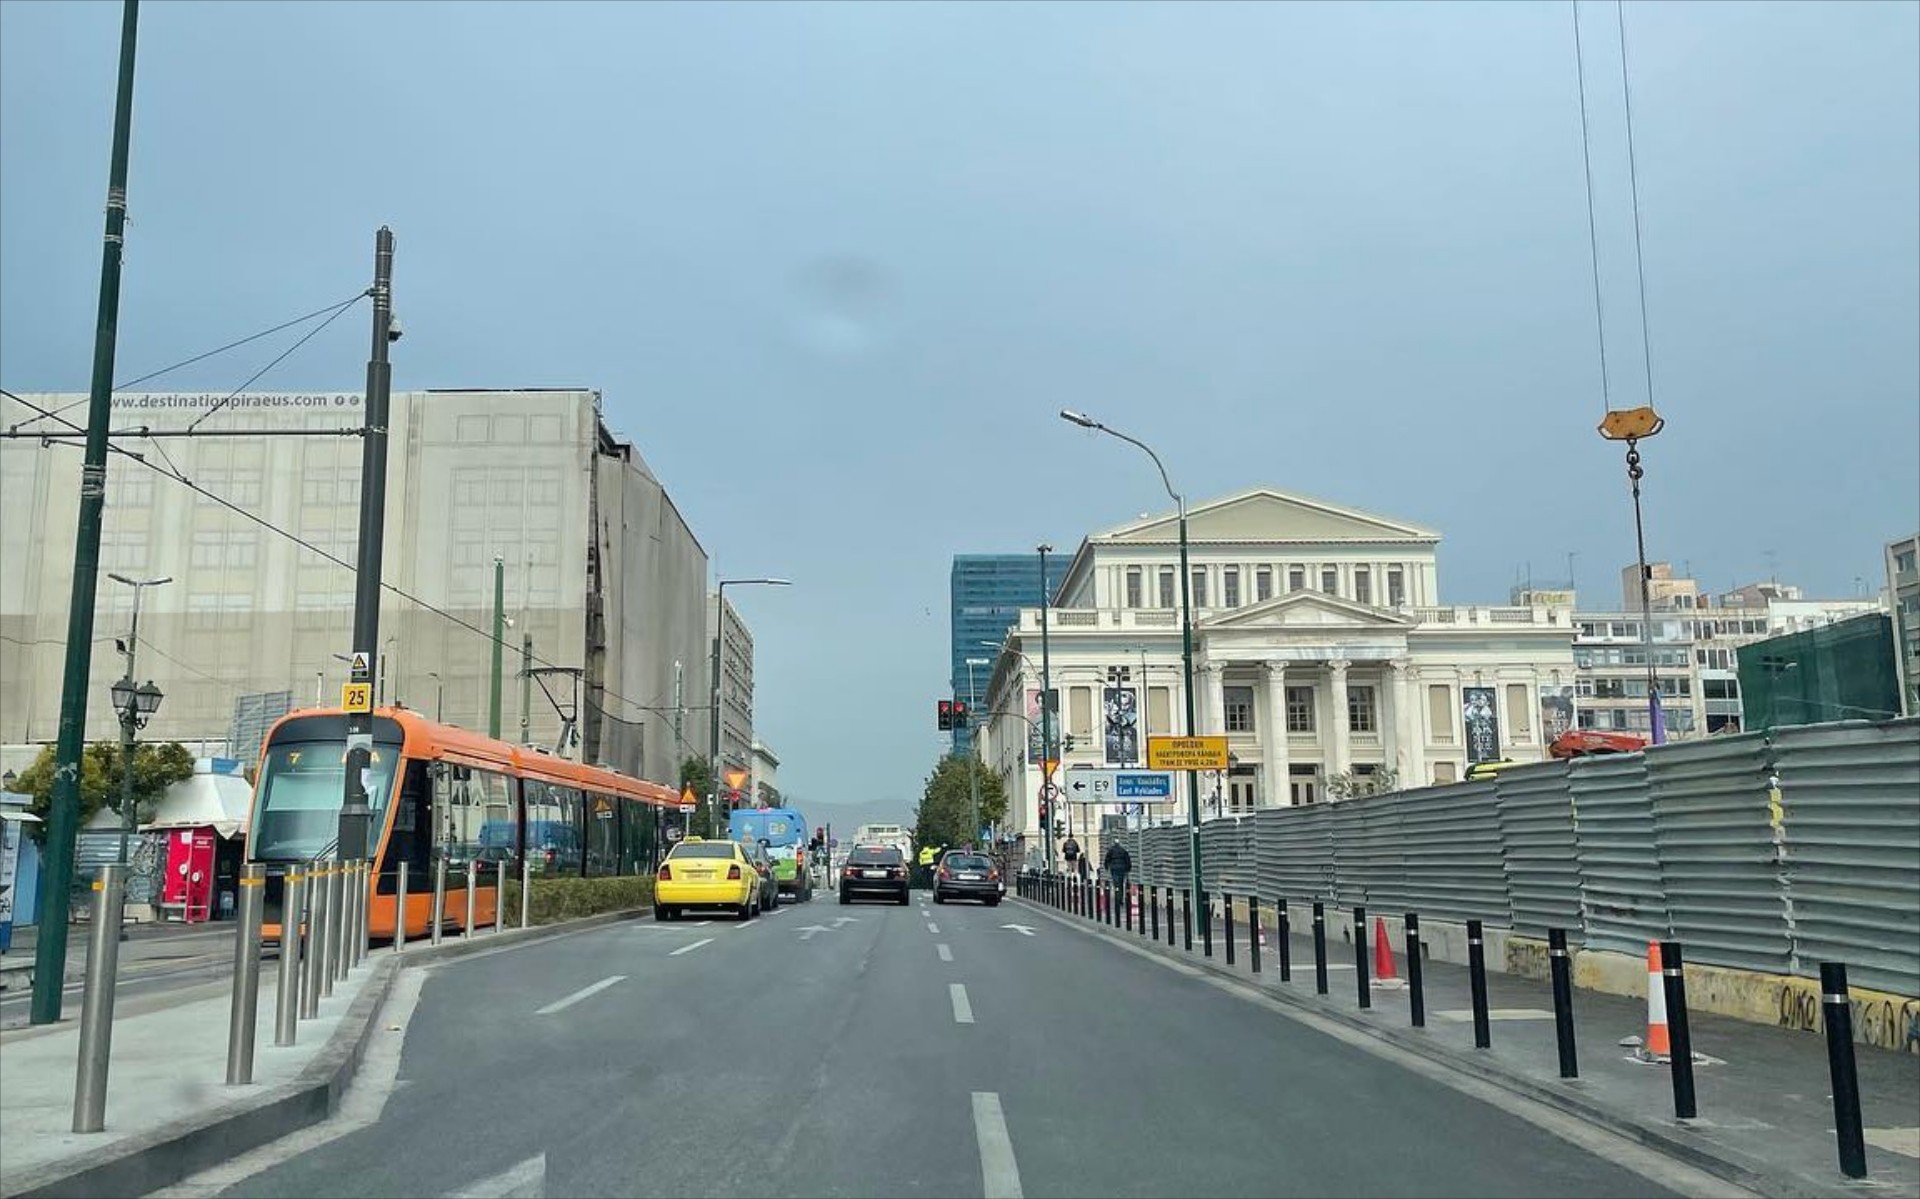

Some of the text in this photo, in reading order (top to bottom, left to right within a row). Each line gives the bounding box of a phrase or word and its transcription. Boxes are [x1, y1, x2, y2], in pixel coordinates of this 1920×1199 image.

[348, 690, 364, 705] 25
[289, 752, 301, 764] 7
[1094, 780, 1109, 792] E9
